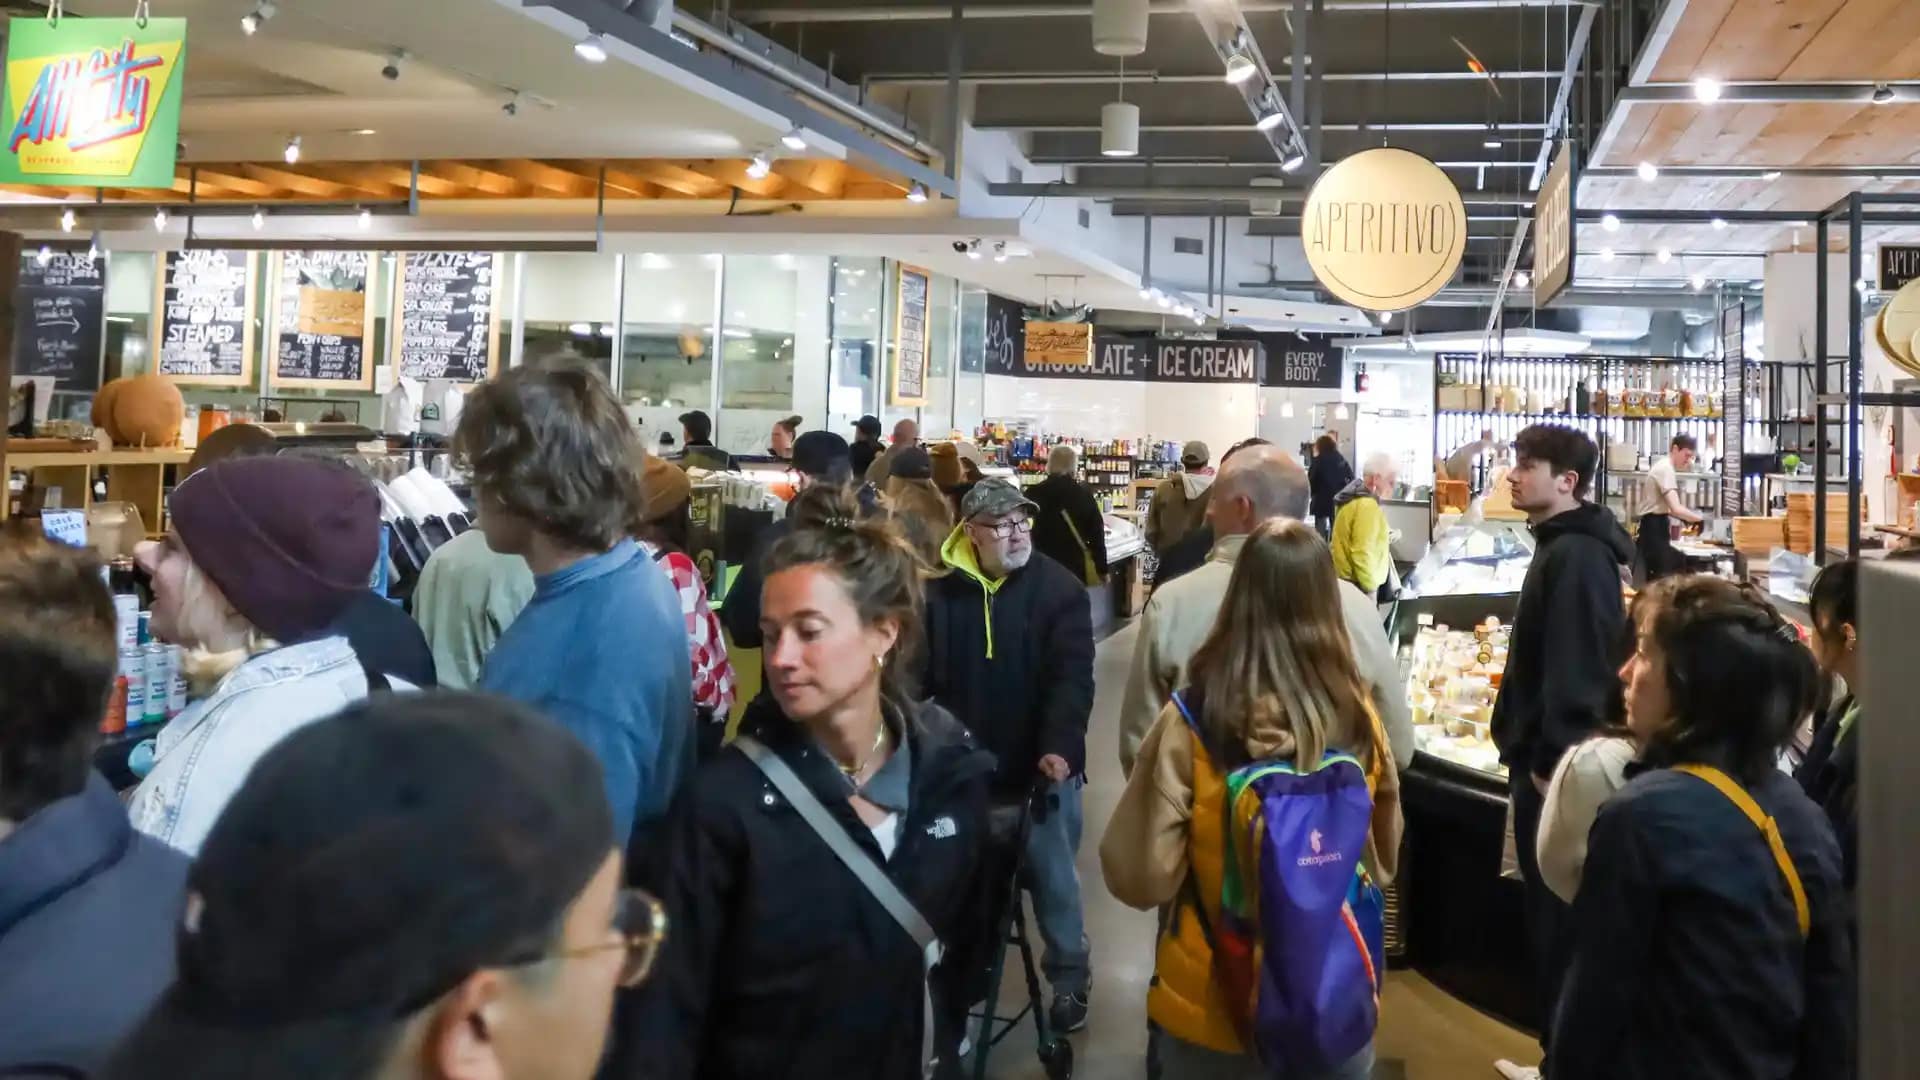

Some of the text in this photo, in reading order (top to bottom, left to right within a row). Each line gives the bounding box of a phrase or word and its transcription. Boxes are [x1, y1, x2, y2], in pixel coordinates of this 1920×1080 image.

[1312, 200, 1445, 254] APERITIVO
[166, 324, 235, 344] STEAMED
[1158, 346, 1186, 377] ICE
[1190, 347, 1254, 379] CREAM
[1285, 352, 1326, 367] EVERY.
[1285, 366, 1320, 382] BODY.
